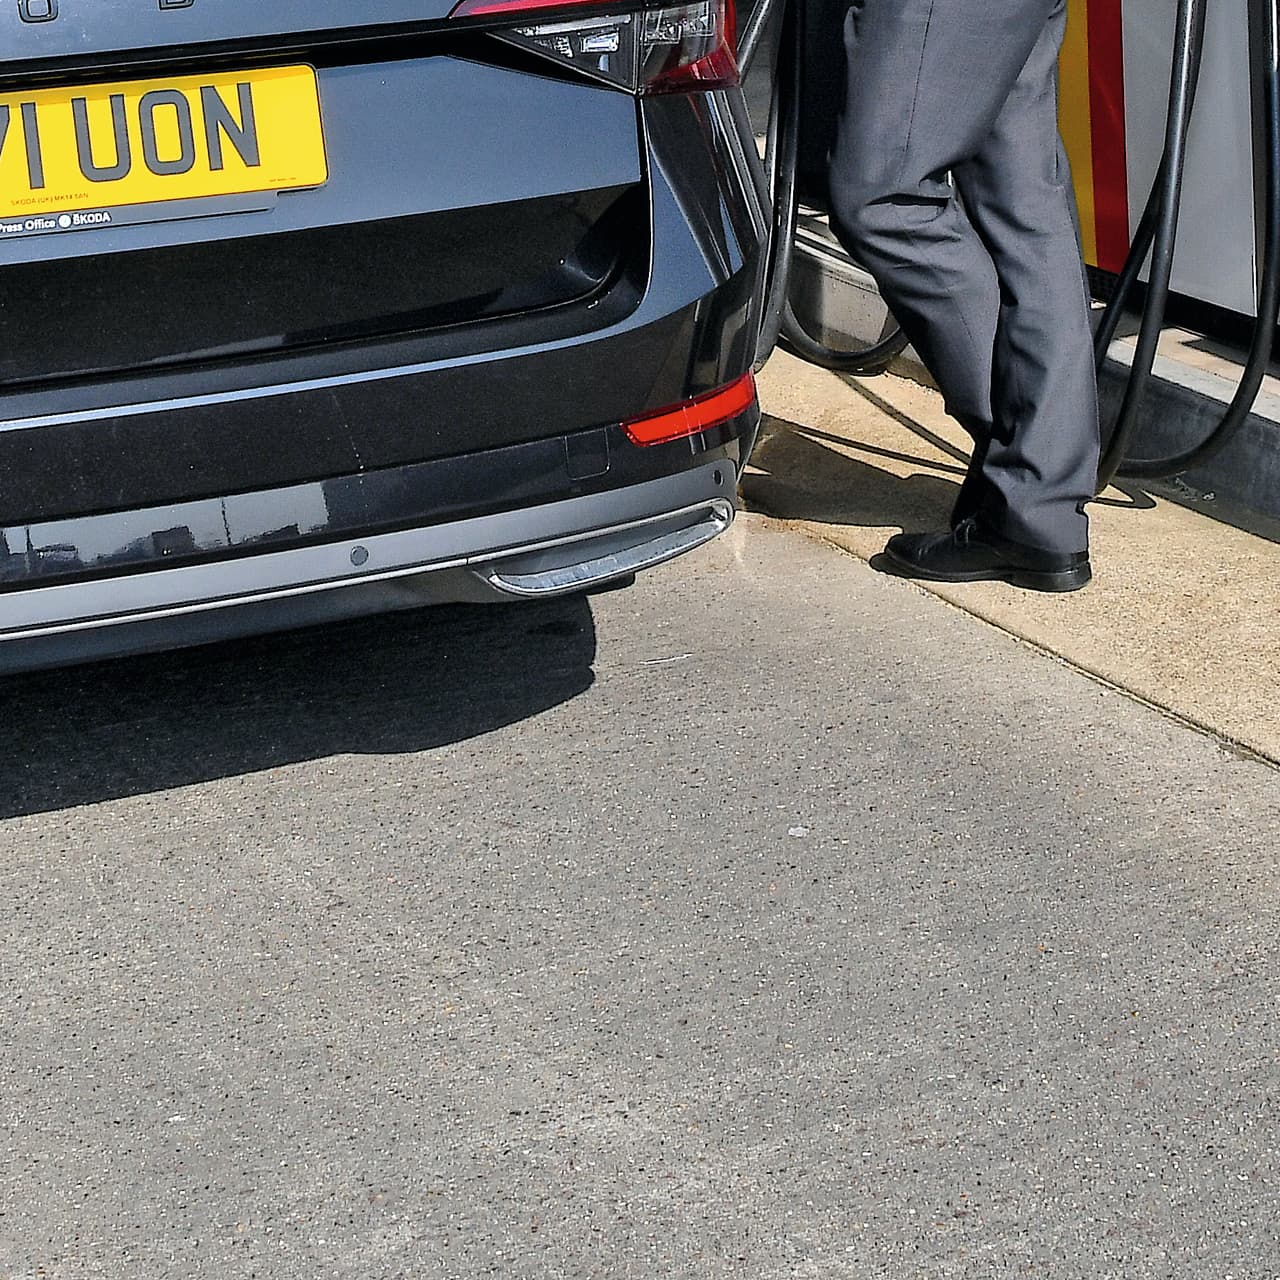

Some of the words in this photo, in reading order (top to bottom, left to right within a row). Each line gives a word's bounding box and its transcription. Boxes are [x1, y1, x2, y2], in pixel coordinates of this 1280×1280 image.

[70, 82, 261, 183] UON
[25, 217, 56, 232] Office
[72, 211, 111, 227] ŠKODA
